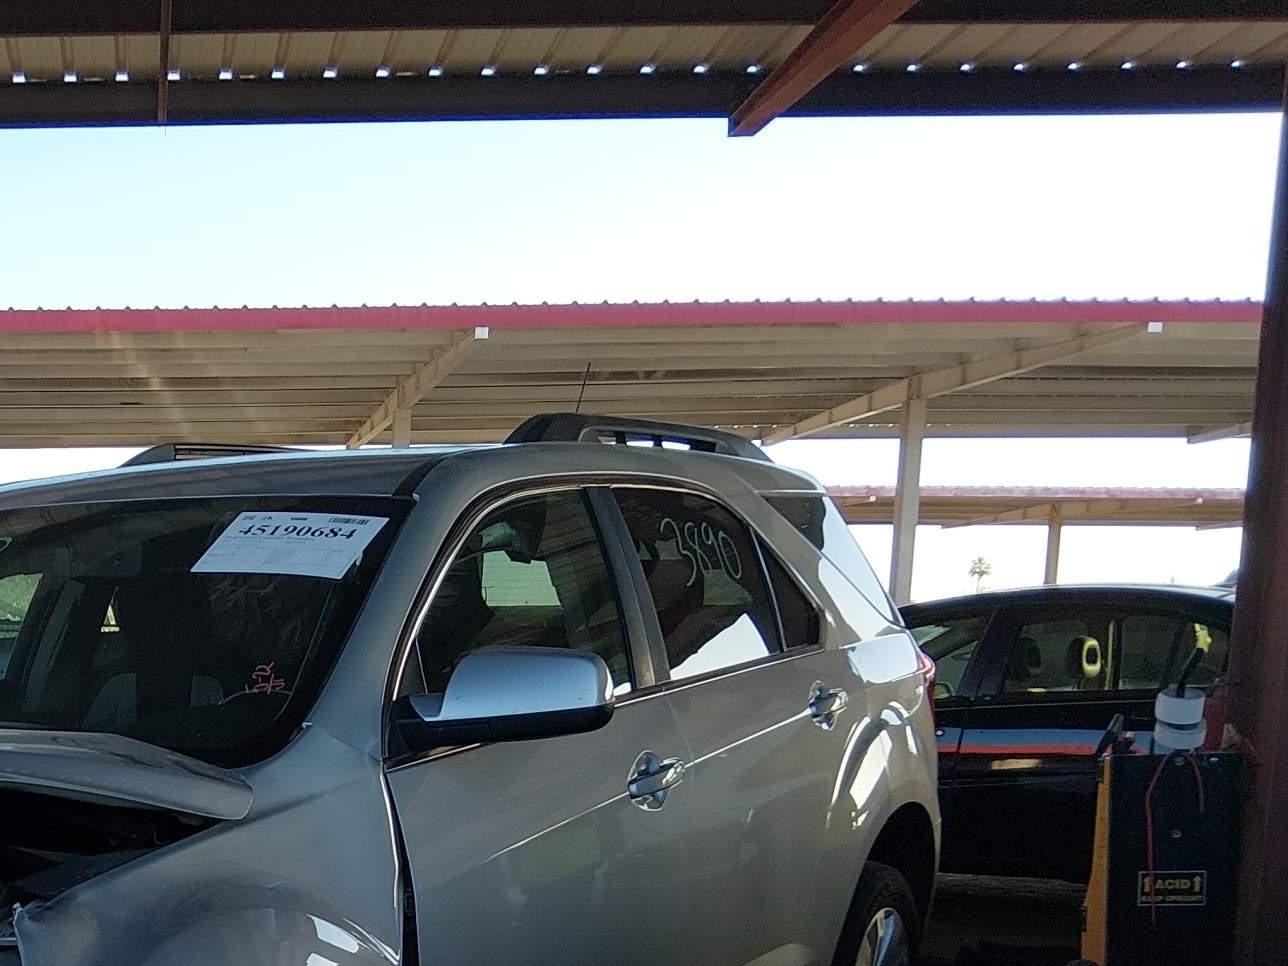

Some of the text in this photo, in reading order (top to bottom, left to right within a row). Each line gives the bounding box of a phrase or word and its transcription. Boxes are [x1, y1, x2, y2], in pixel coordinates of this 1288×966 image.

[239, 524, 358, 540] 45190684
[659, 517, 743, 587] 3890
[1154, 878, 1192, 890] ACID
